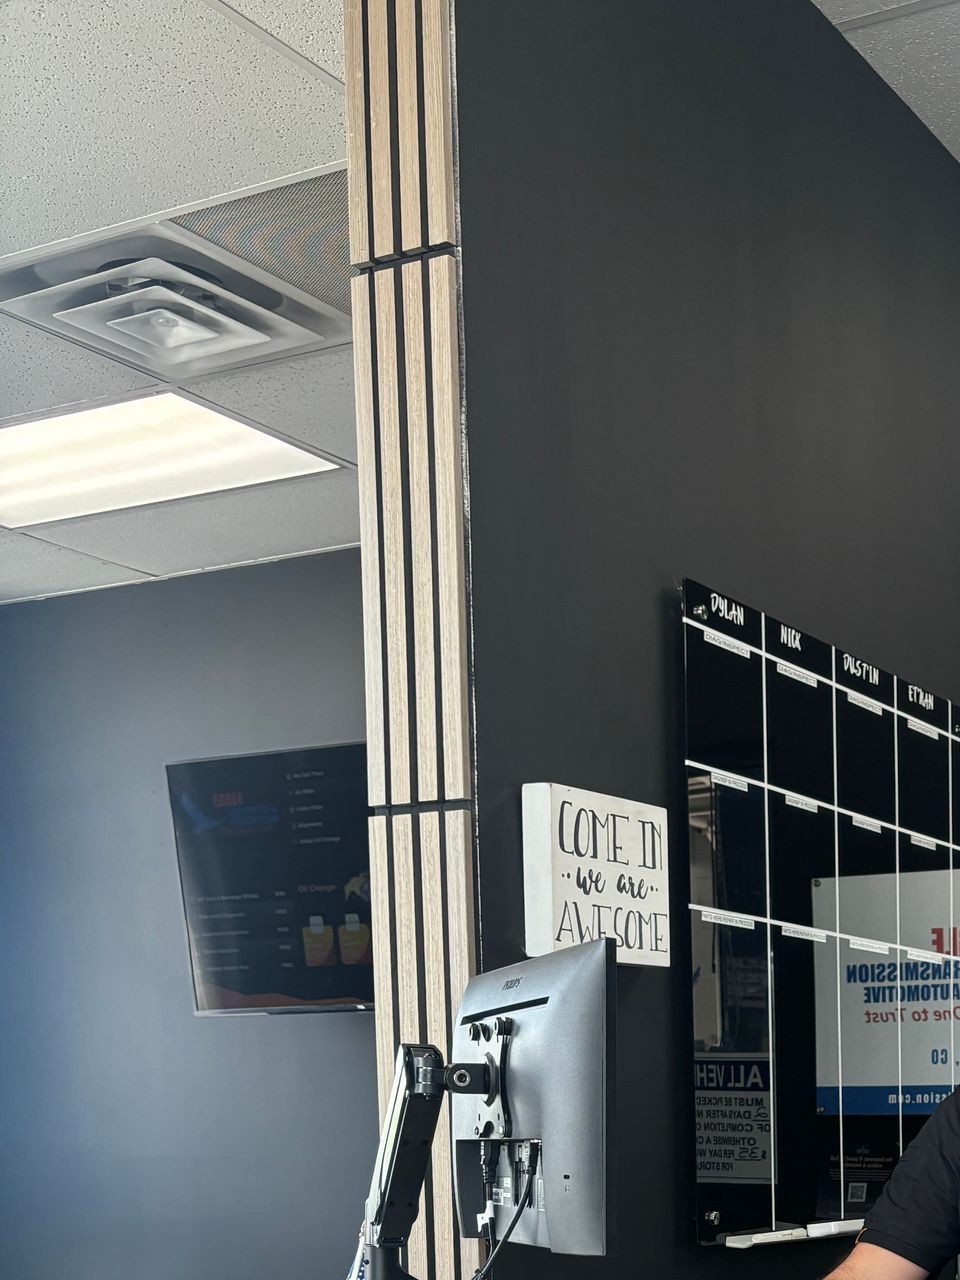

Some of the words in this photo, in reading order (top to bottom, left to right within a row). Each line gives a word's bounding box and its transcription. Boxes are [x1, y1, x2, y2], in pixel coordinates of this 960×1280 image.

[710, 592, 744, 626] DYLAN
[780, 624, 802, 651] NICK
[843, 653, 879, 686] DUSTIN
[908, 685, 934, 711] ETHAN
[558, 800, 630, 865] COME
[638, 820, 663, 870] IN
[555, 900, 668, 953] AWESOME
